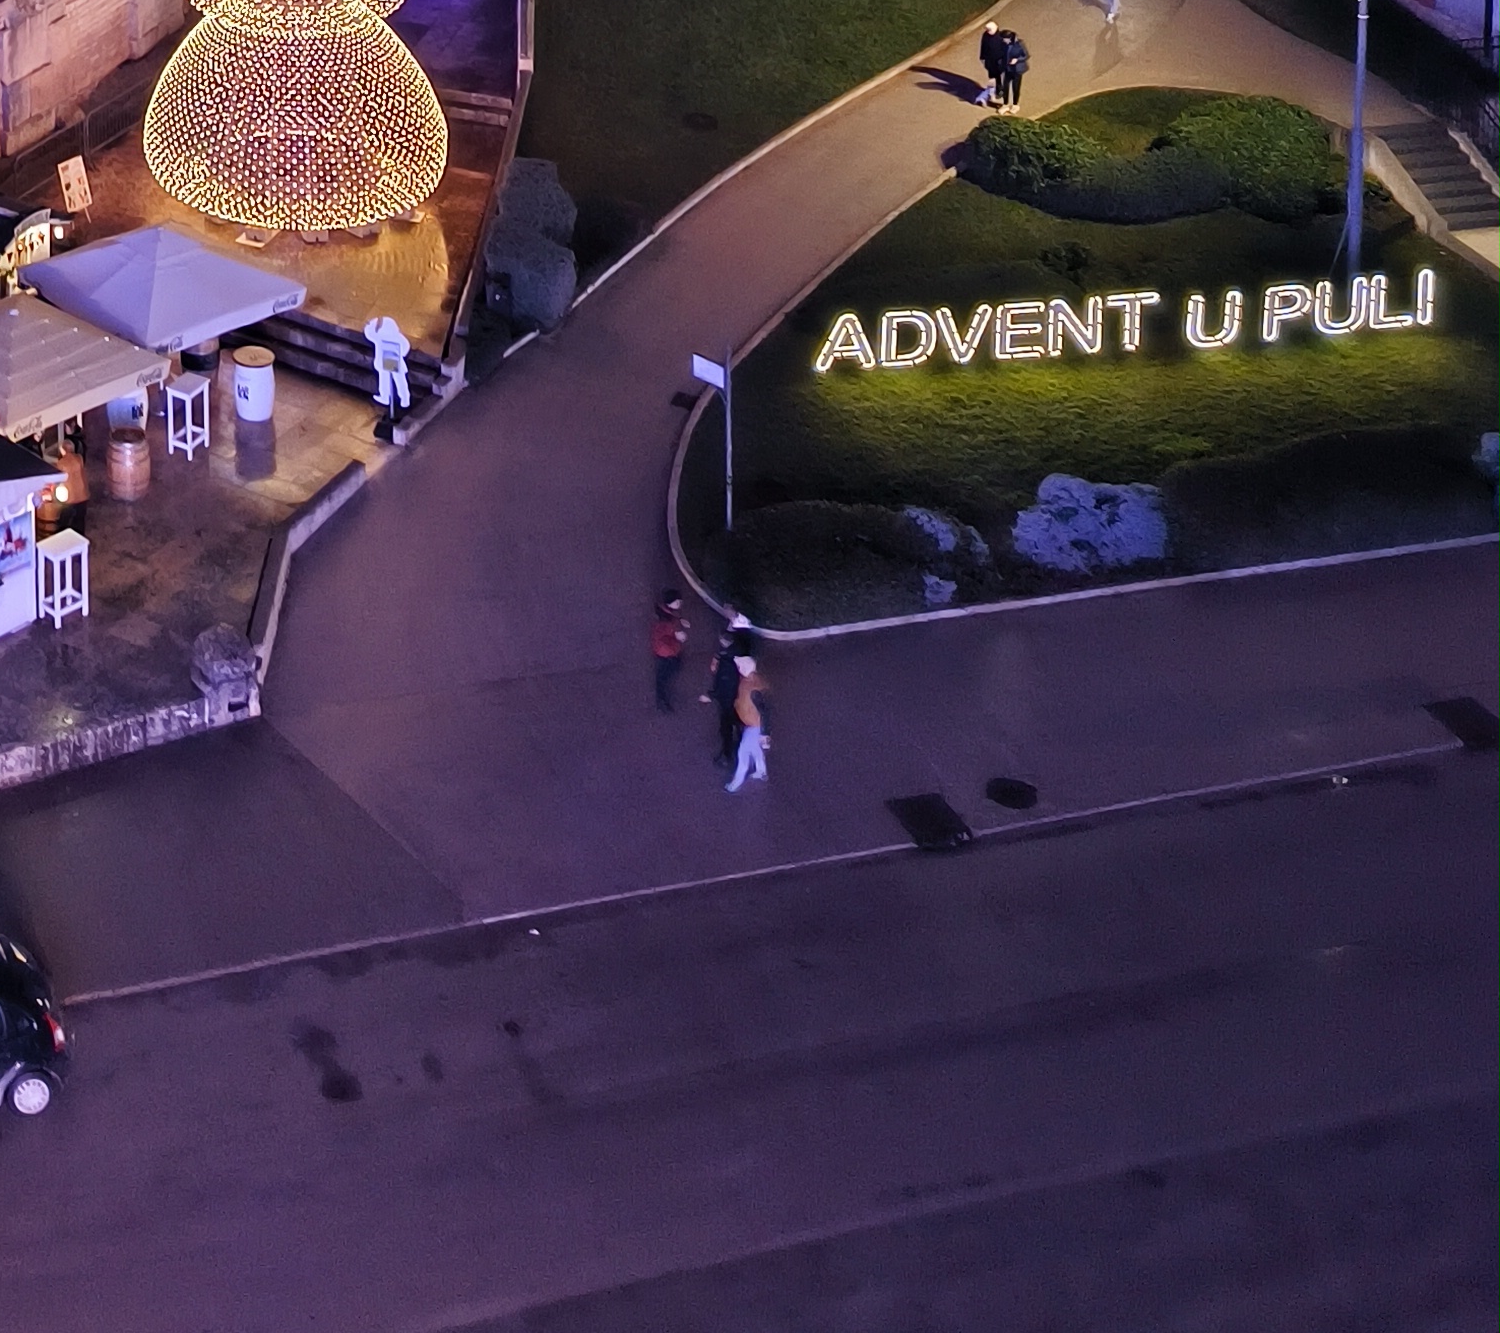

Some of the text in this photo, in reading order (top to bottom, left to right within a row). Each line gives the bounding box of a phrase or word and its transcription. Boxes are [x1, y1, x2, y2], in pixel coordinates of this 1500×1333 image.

[813, 267, 1436, 374] ADVENT U PULI
